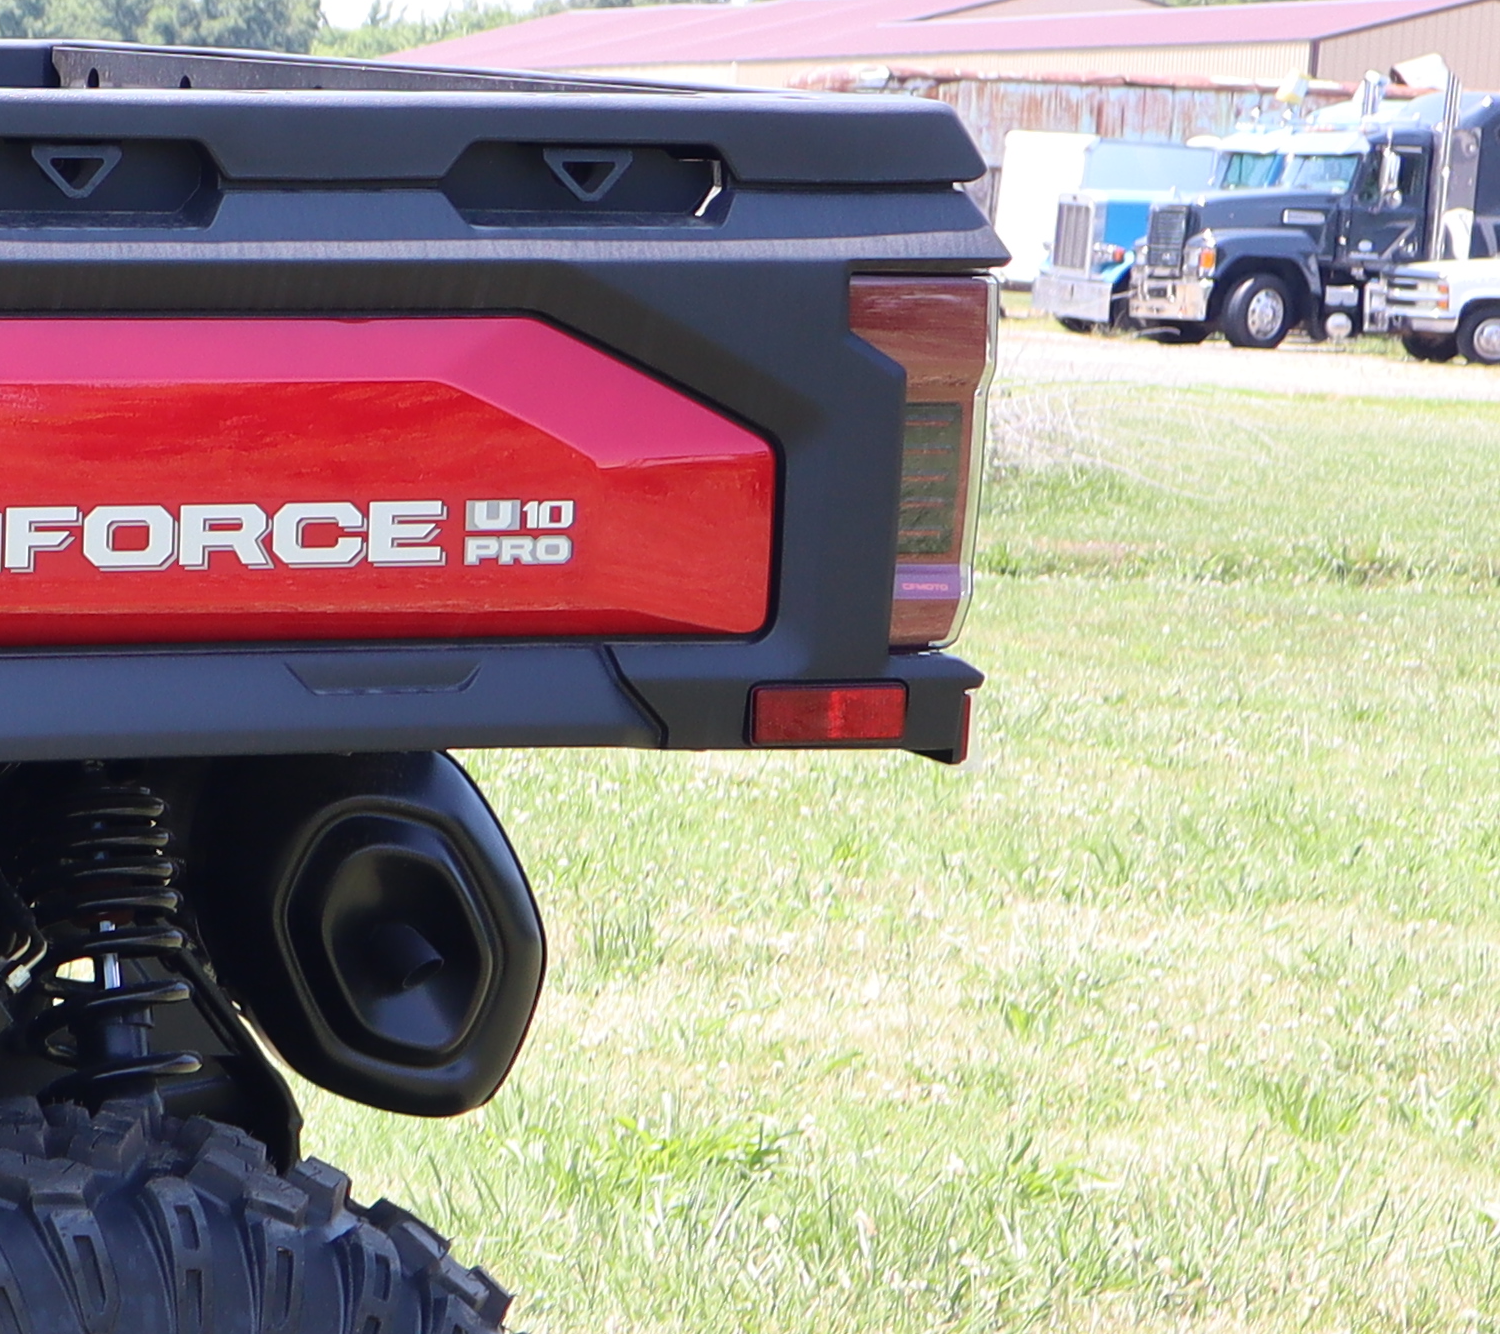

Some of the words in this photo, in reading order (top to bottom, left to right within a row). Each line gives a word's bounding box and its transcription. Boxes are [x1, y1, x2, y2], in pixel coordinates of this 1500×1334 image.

[464, 498, 576, 531] U10
[464, 534, 574, 565] PRO
[901, 582, 949, 591] CFMOTO
